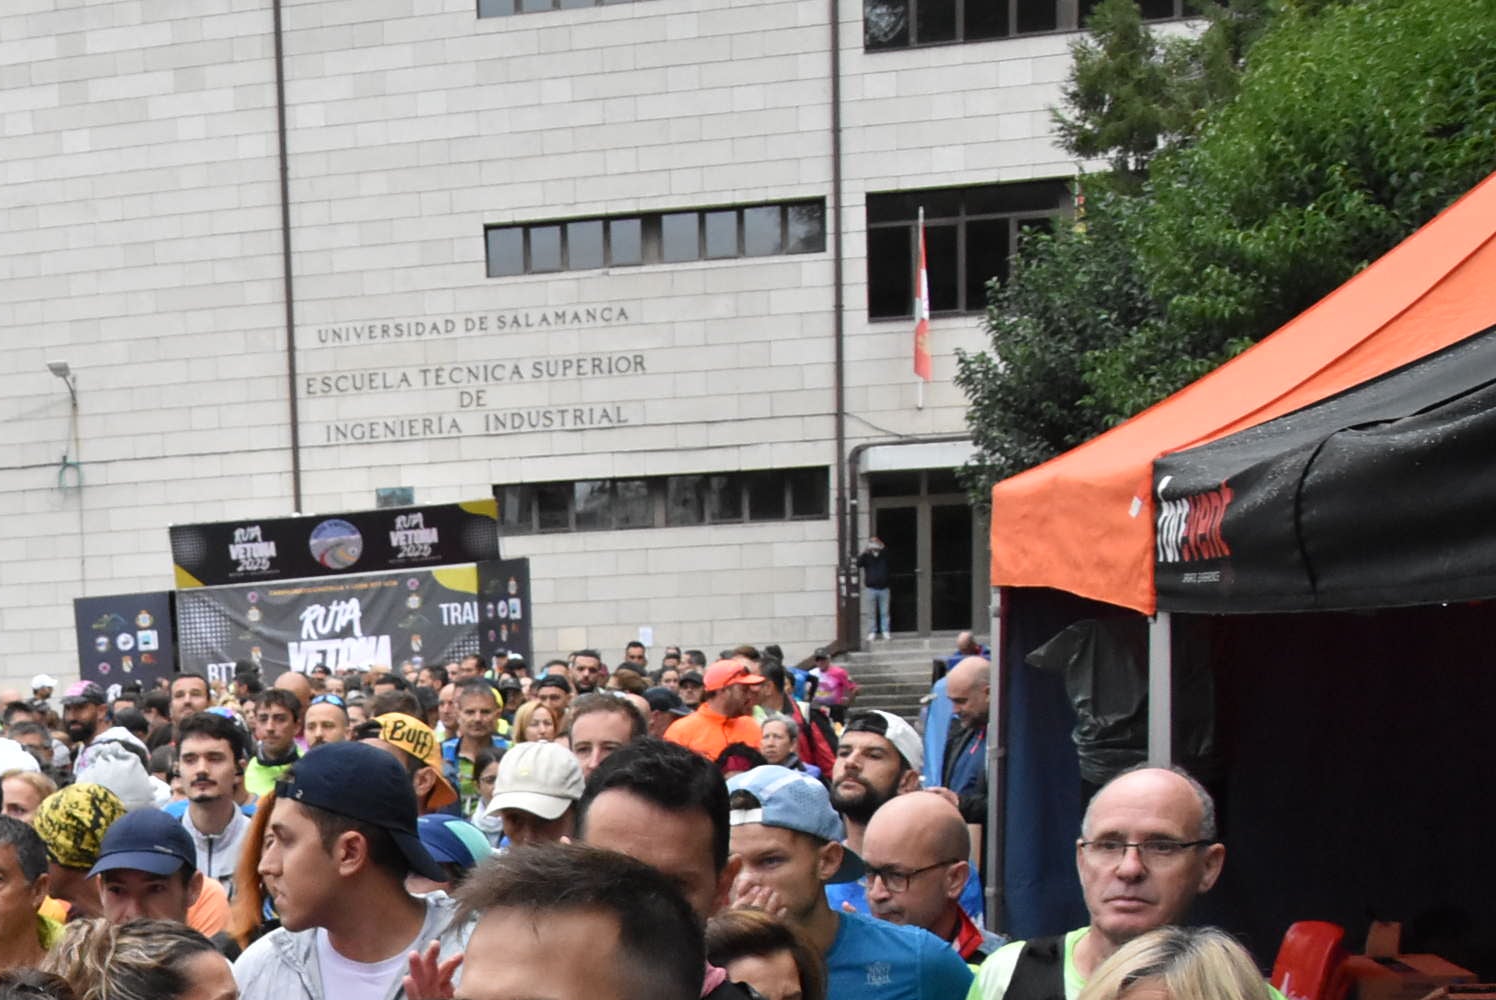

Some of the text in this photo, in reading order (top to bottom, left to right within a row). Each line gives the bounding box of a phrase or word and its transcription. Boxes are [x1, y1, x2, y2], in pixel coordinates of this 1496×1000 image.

[317, 306, 630, 344] UNIVERSIDAD DE SALAMANCA
[306, 371, 413, 396] ESCUELA
[531, 353, 647, 380] SUPERIOR
[459, 389, 488, 409] DE
[326, 405, 630, 443] INGENIERÍA INDUSTRIAL
[236, 557, 271, 573] 2025
[397, 543, 432, 559] 2025
[299, 597, 363, 640] RUTA
[438, 601, 479, 626] TRAI
[389, 720, 430, 755] Buff
